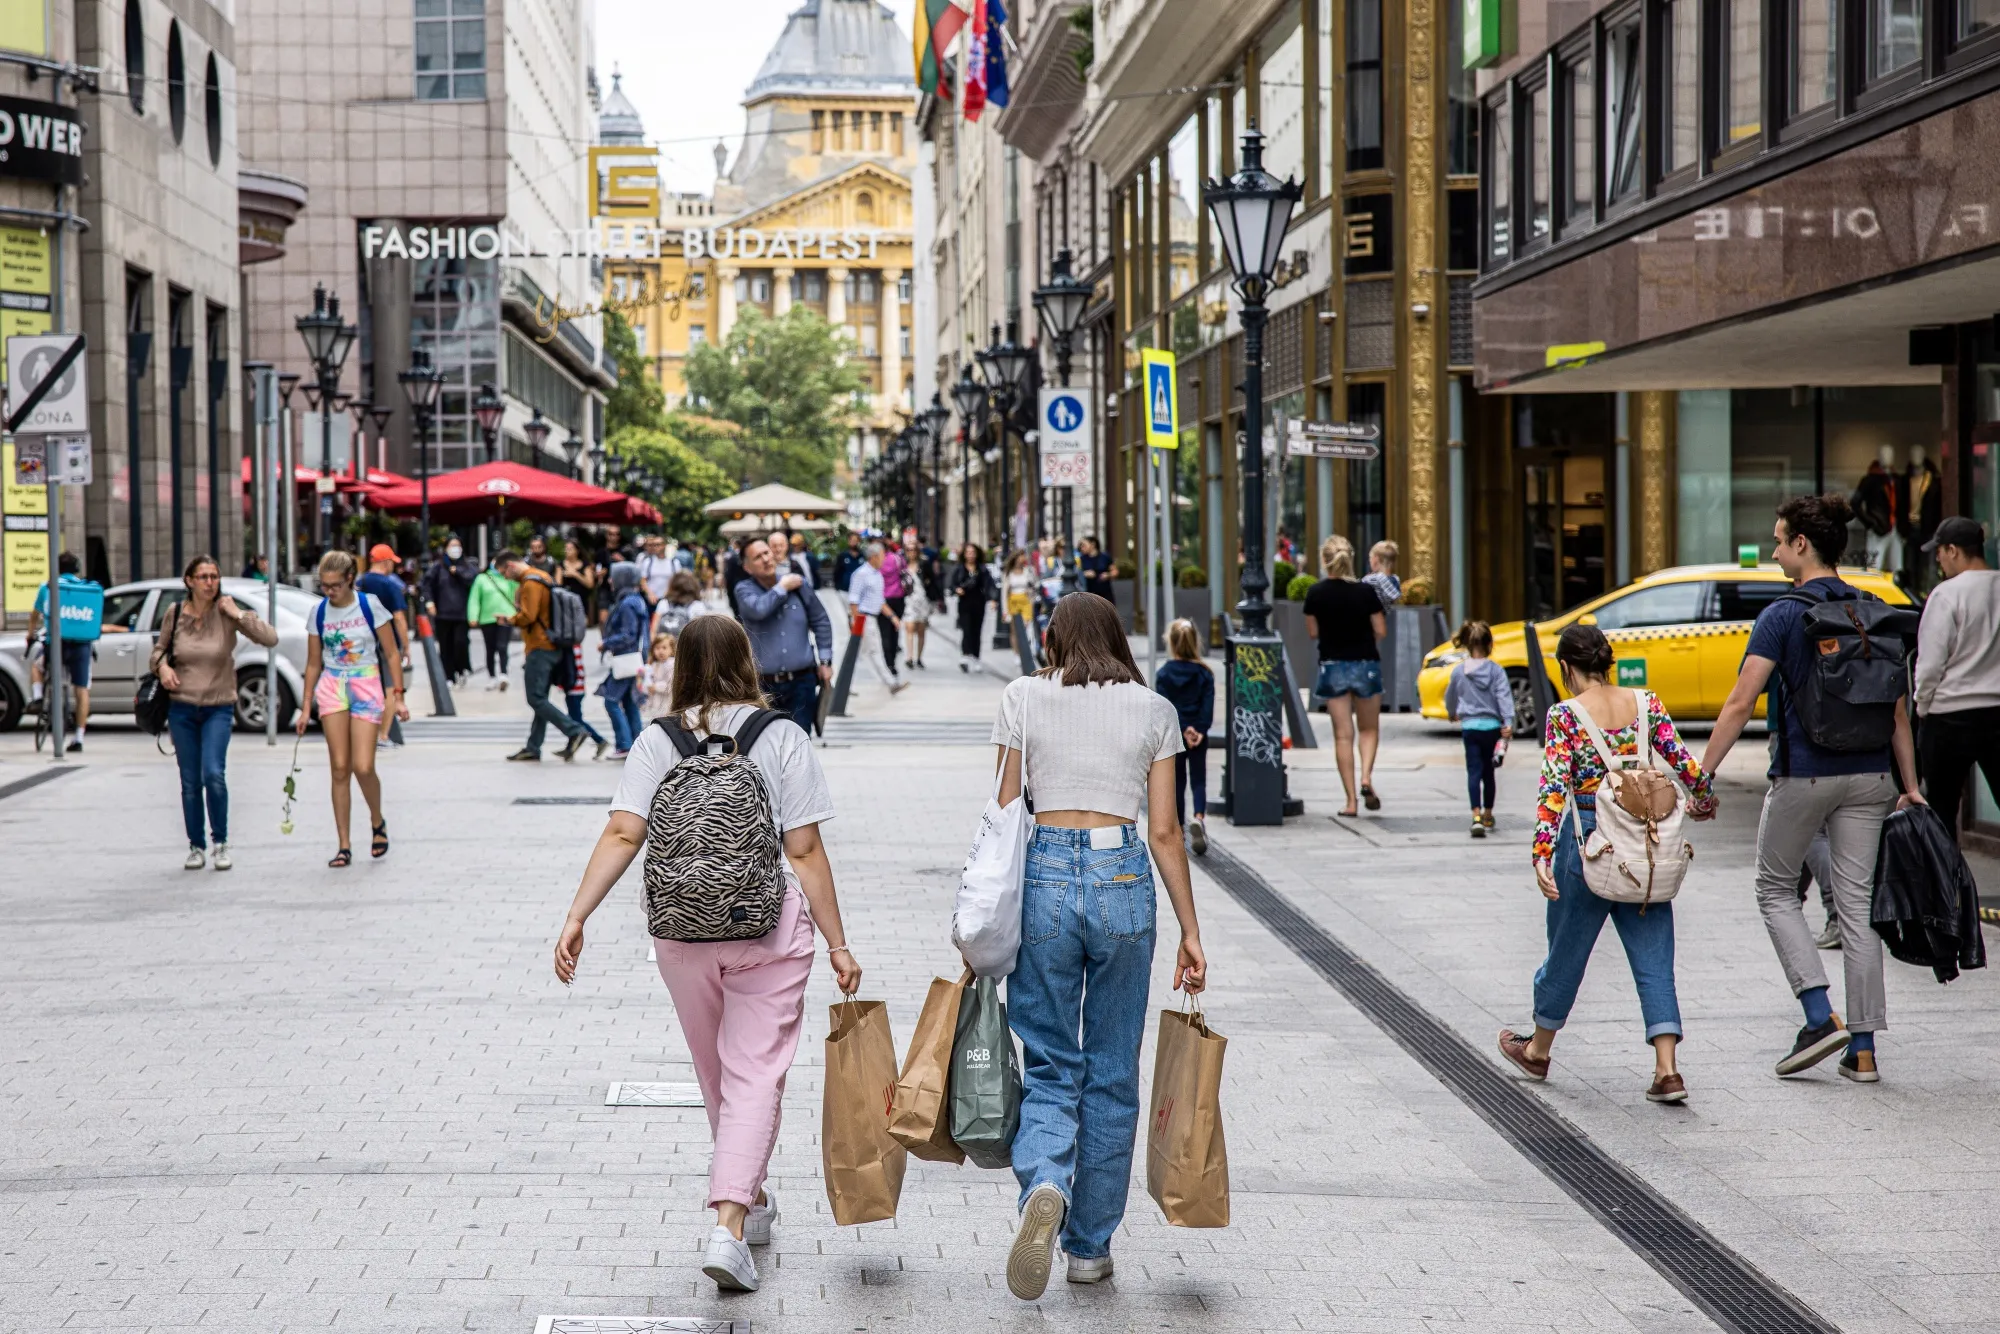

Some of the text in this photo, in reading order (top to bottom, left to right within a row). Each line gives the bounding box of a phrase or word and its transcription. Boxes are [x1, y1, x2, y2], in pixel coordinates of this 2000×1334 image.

[364, 226, 882, 260] FASHION STREET BUDAPEST
[534, 292, 603, 344] Your
[60, 604, 94, 621] Wolt
[967, 1049, 991, 1062] P&B
